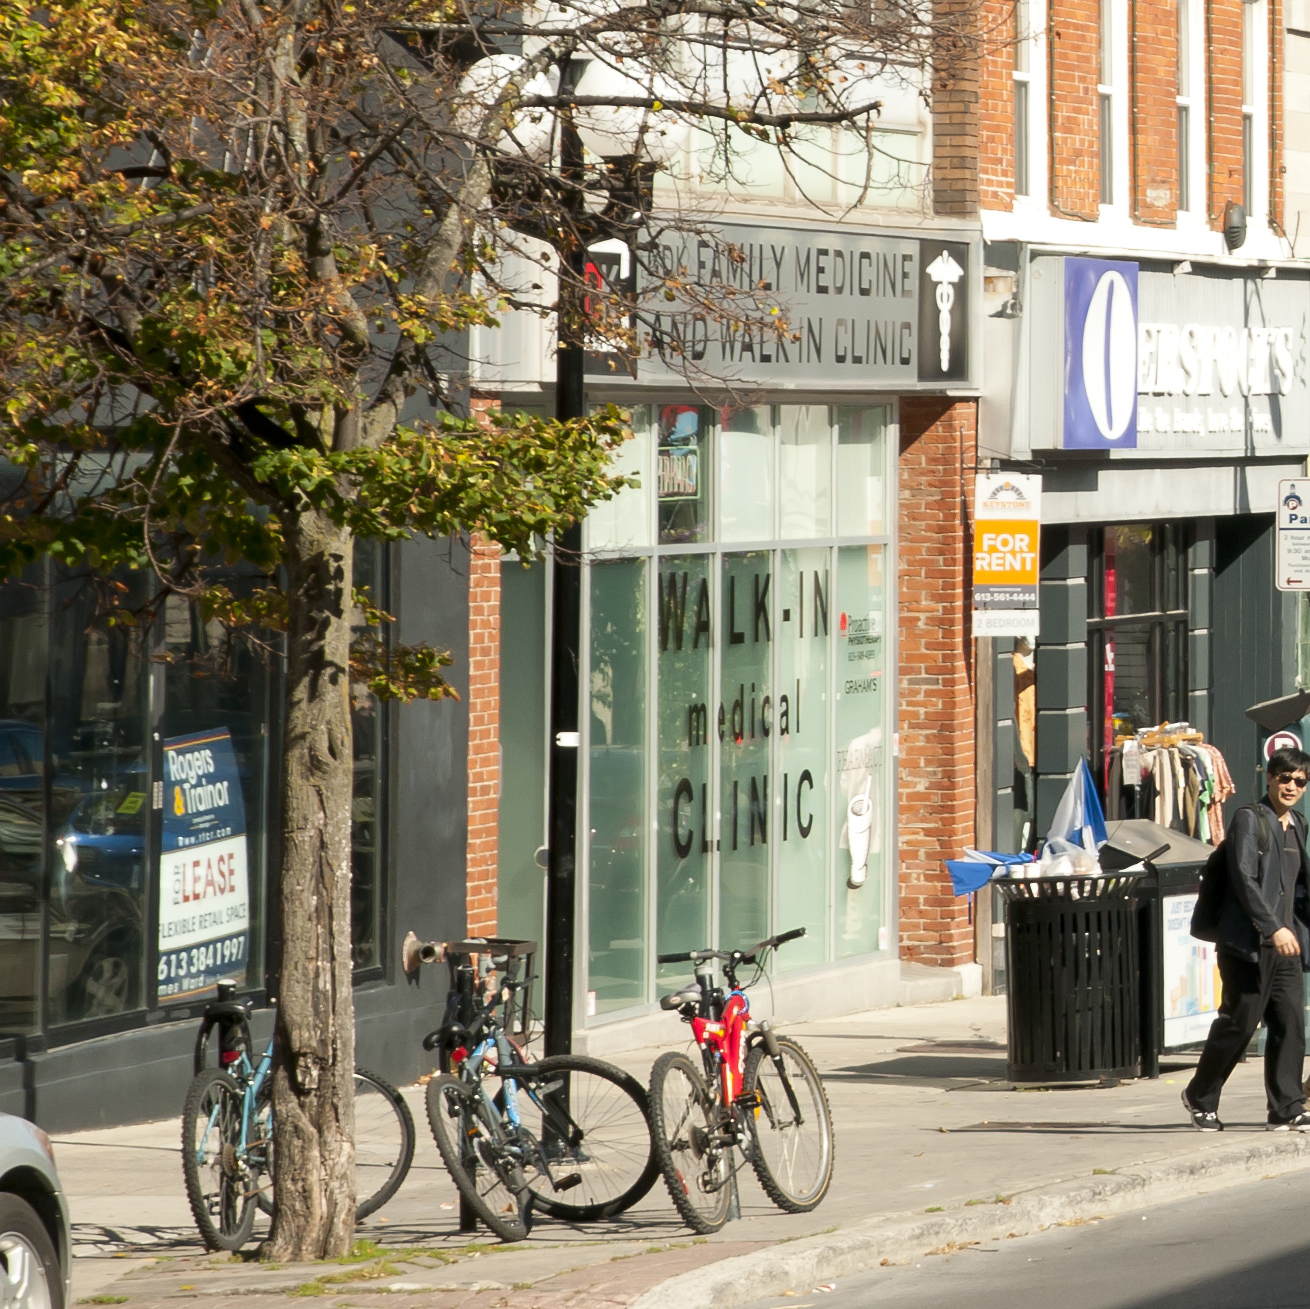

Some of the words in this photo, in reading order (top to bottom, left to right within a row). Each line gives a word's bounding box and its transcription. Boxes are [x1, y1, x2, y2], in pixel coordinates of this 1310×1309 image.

[697, 240, 786, 292] FAMILY
[795, 245, 915, 299] MEDICINE
[833, 318, 913, 367] CLINIC
[982, 500, 1033, 510] KEYSTONE
[975, 552, 1036, 572] RENT
[982, 533, 1030, 552] FOR
[656, 568, 831, 653] WALK-IN
[974, 592, 1036, 602] 613-561-4444
[976, 618, 983, 629] 2
[986, 617, 1035, 629] BEDROOM
[845, 677, 878, 695] GRAHAM'S
[687, 677, 801, 748] medical
[167, 748, 215, 785] Rogers
[173, 785, 186, 817] &
[182, 777, 230, 814] Trainor
[672, 767, 815, 861] CLINIC
[172, 864, 182, 906] FOR
[182, 852, 236, 904] LEASE
[198, 909, 224, 931] RETAIL
[226, 902, 247, 924] SPACE
[157, 951, 188, 982] 613
[190, 942, 214, 974] 384
[216, 935, 246, 967] 1997
